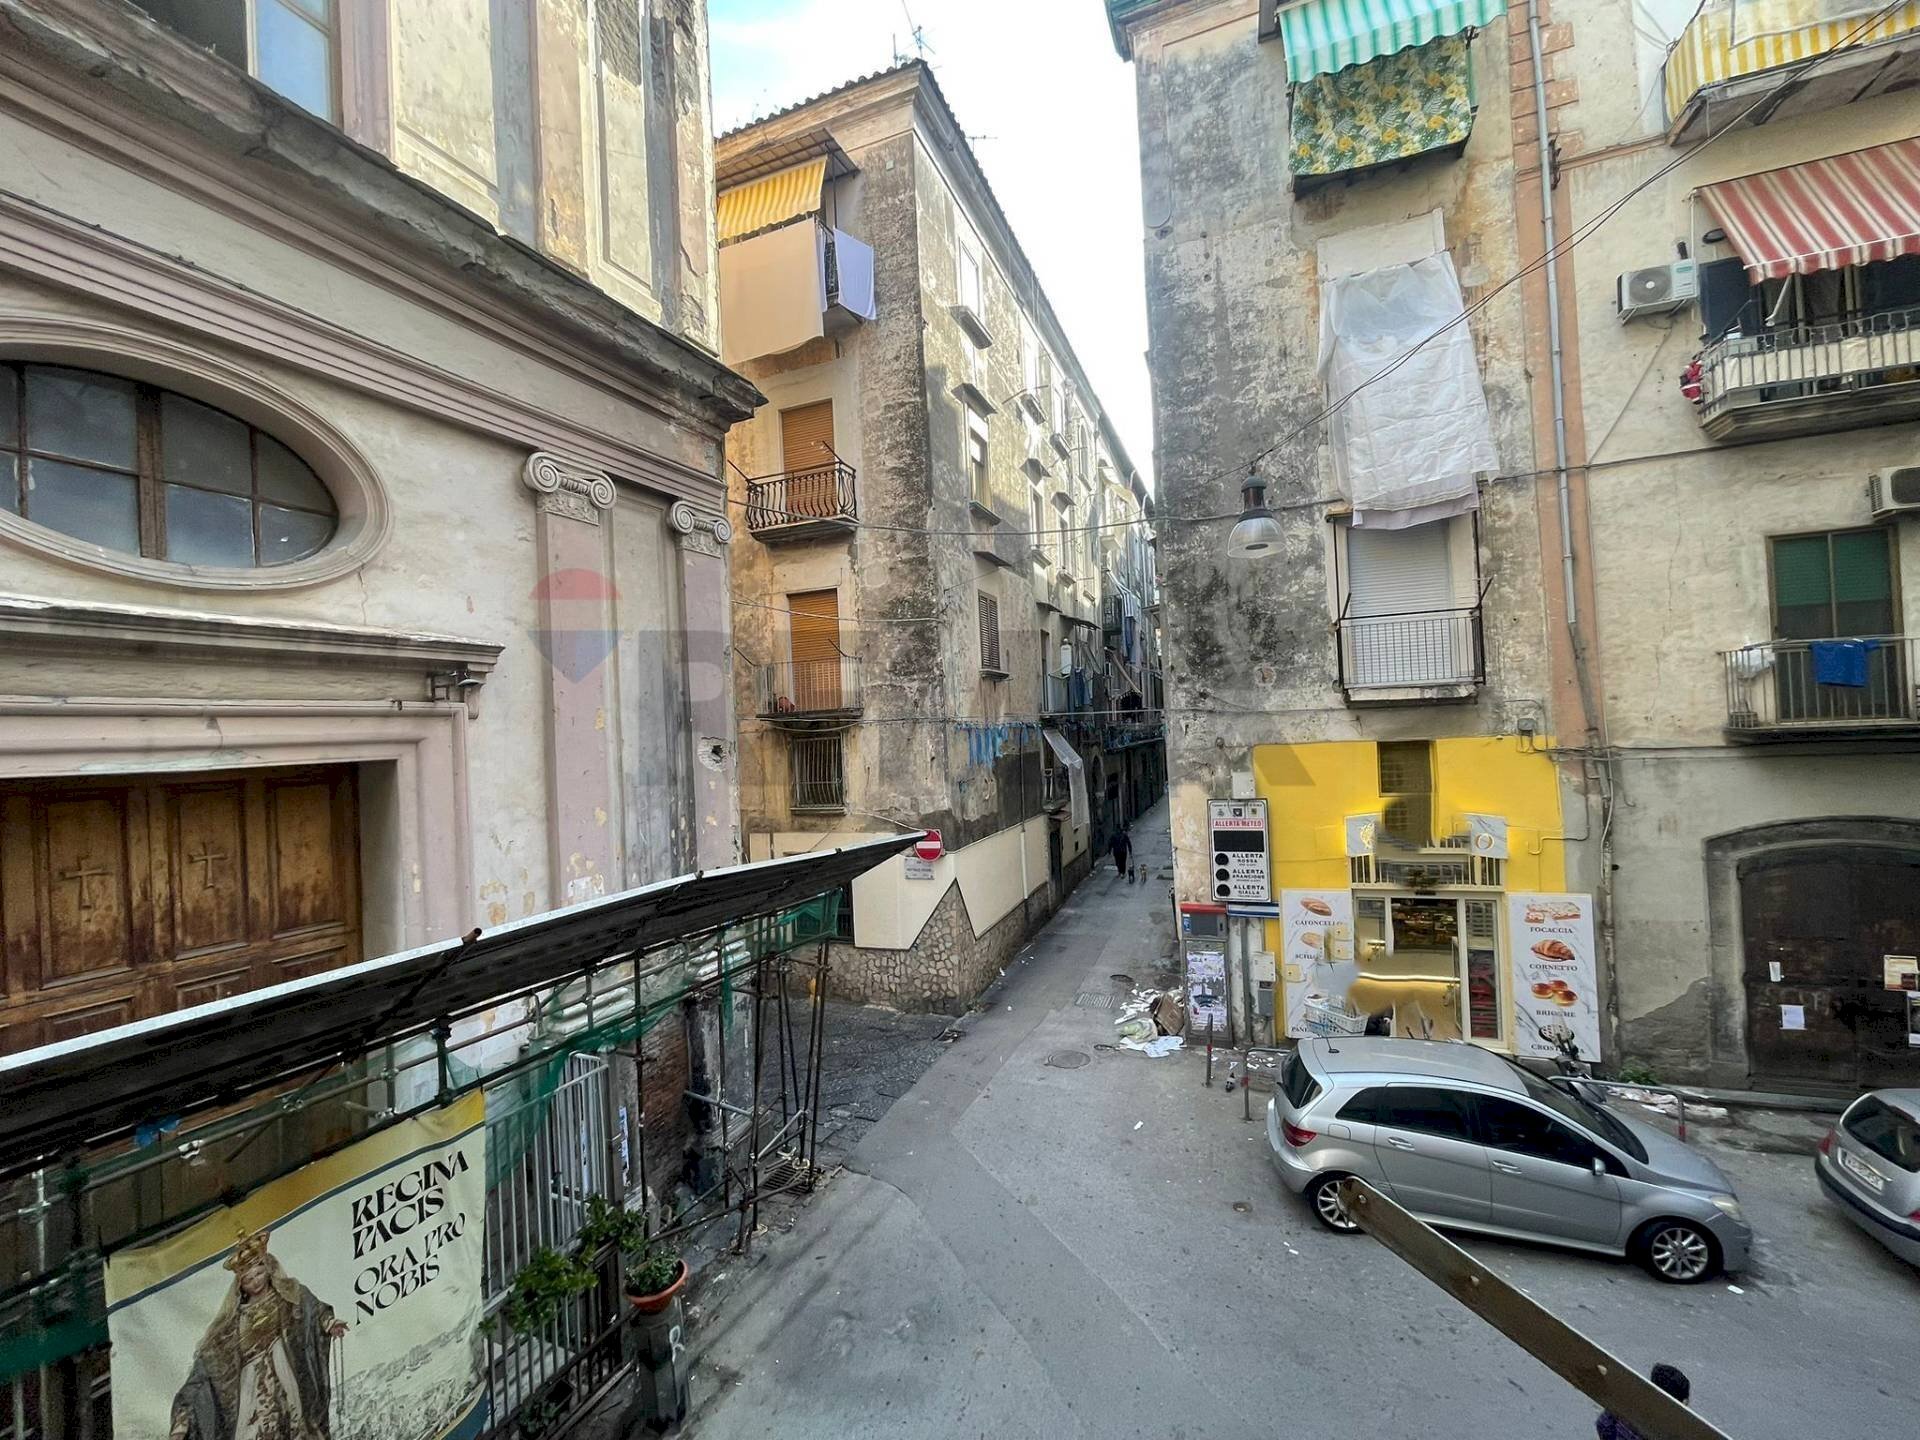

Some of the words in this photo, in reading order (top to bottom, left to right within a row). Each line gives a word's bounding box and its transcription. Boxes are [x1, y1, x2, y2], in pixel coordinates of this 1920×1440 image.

[1214, 820, 1240, 828] ALLERTA
[1241, 820, 1262, 828] METEO
[1530, 926, 1573, 934] FOCACCIA
[1529, 963, 1578, 971] CORNETTO
[352, 1151, 469, 1230] REGINA
[353, 1188, 444, 1260] PACIS
[354, 1247, 419, 1295] ORA
[424, 1213, 466, 1258] PRO
[355, 1254, 440, 1326] NOBIS
